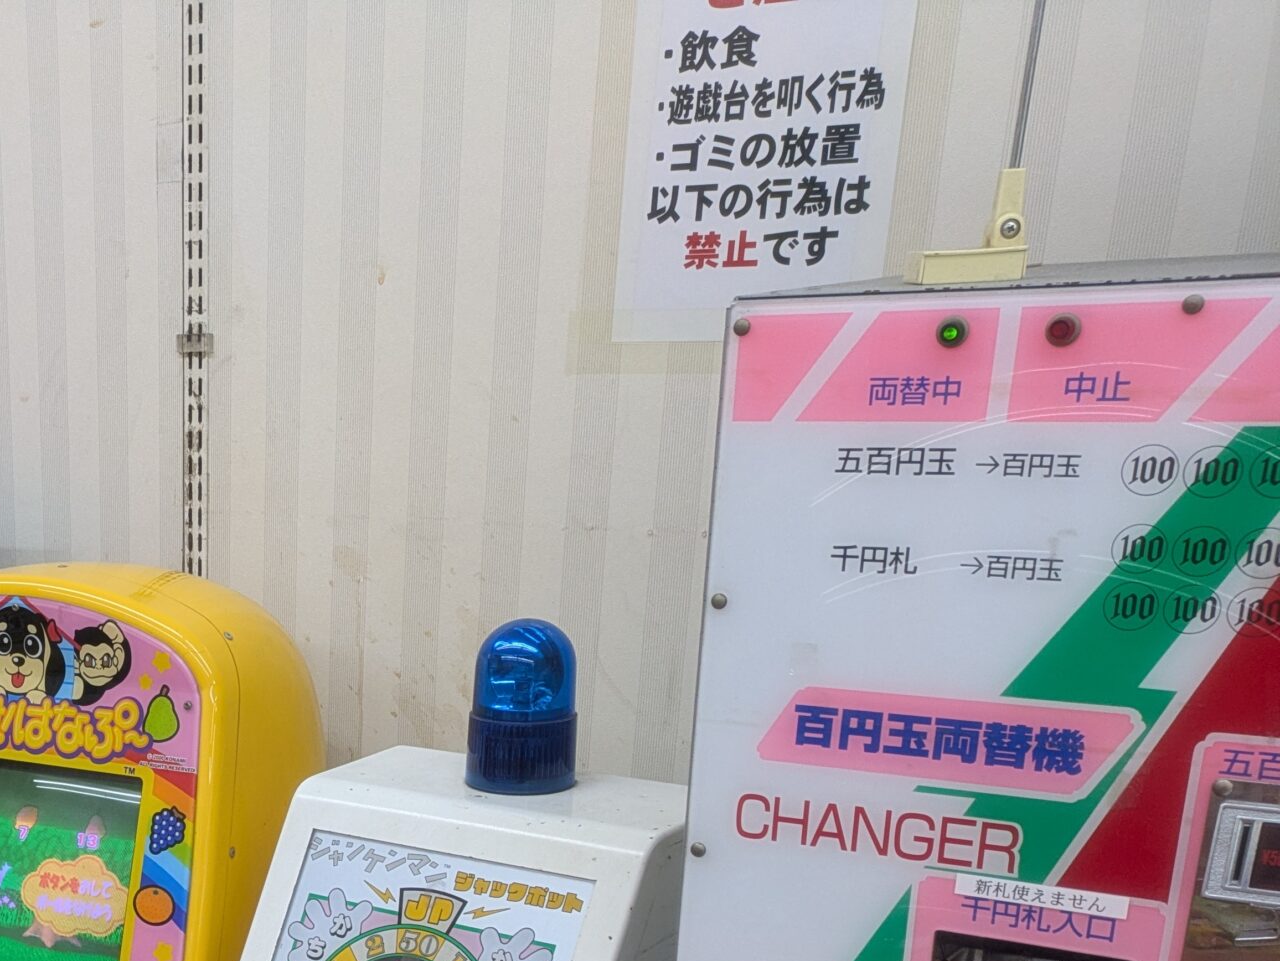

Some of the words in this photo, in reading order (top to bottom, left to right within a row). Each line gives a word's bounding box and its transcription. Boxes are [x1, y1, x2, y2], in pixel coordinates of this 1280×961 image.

[647, 175, 870, 224] 以下の行為は
[683, 226, 839, 270] 禁止です
[868, 376, 962, 407] 両替中
[1063, 371, 1131, 404] 中止
[834, 447, 957, 477] 五百円玉
[1002, 453, 1081, 479] 百円玉
[1128, 456, 1176, 484] 100
[1190, 457, 1239, 486] 100
[1257, 457, 1280, 487] 10
[830, 544, 918, 575] 千円札
[986, 555, 1064, 582] 百円玉
[1120, 535, 1164, 563] 100
[1179, 537, 1228, 566] 100
[1110, 593, 1155, 621] 100
[1171, 595, 1218, 623] 100
[794, 703, 1085, 776] 百円玉両替機
[124, 766, 136, 775] TM
[19, 826, 29, 841] 7
[77, 833, 100, 850] 13
[735, 793, 1020, 874] CHANGER
[310, 837, 448, 884] ジャンケンマン
[453, 870, 584, 914] ジャックポット
[974, 879, 1106, 913] 新札使えません
[404, 894, 455, 926] JP
[399, 930, 439, 957] 50
